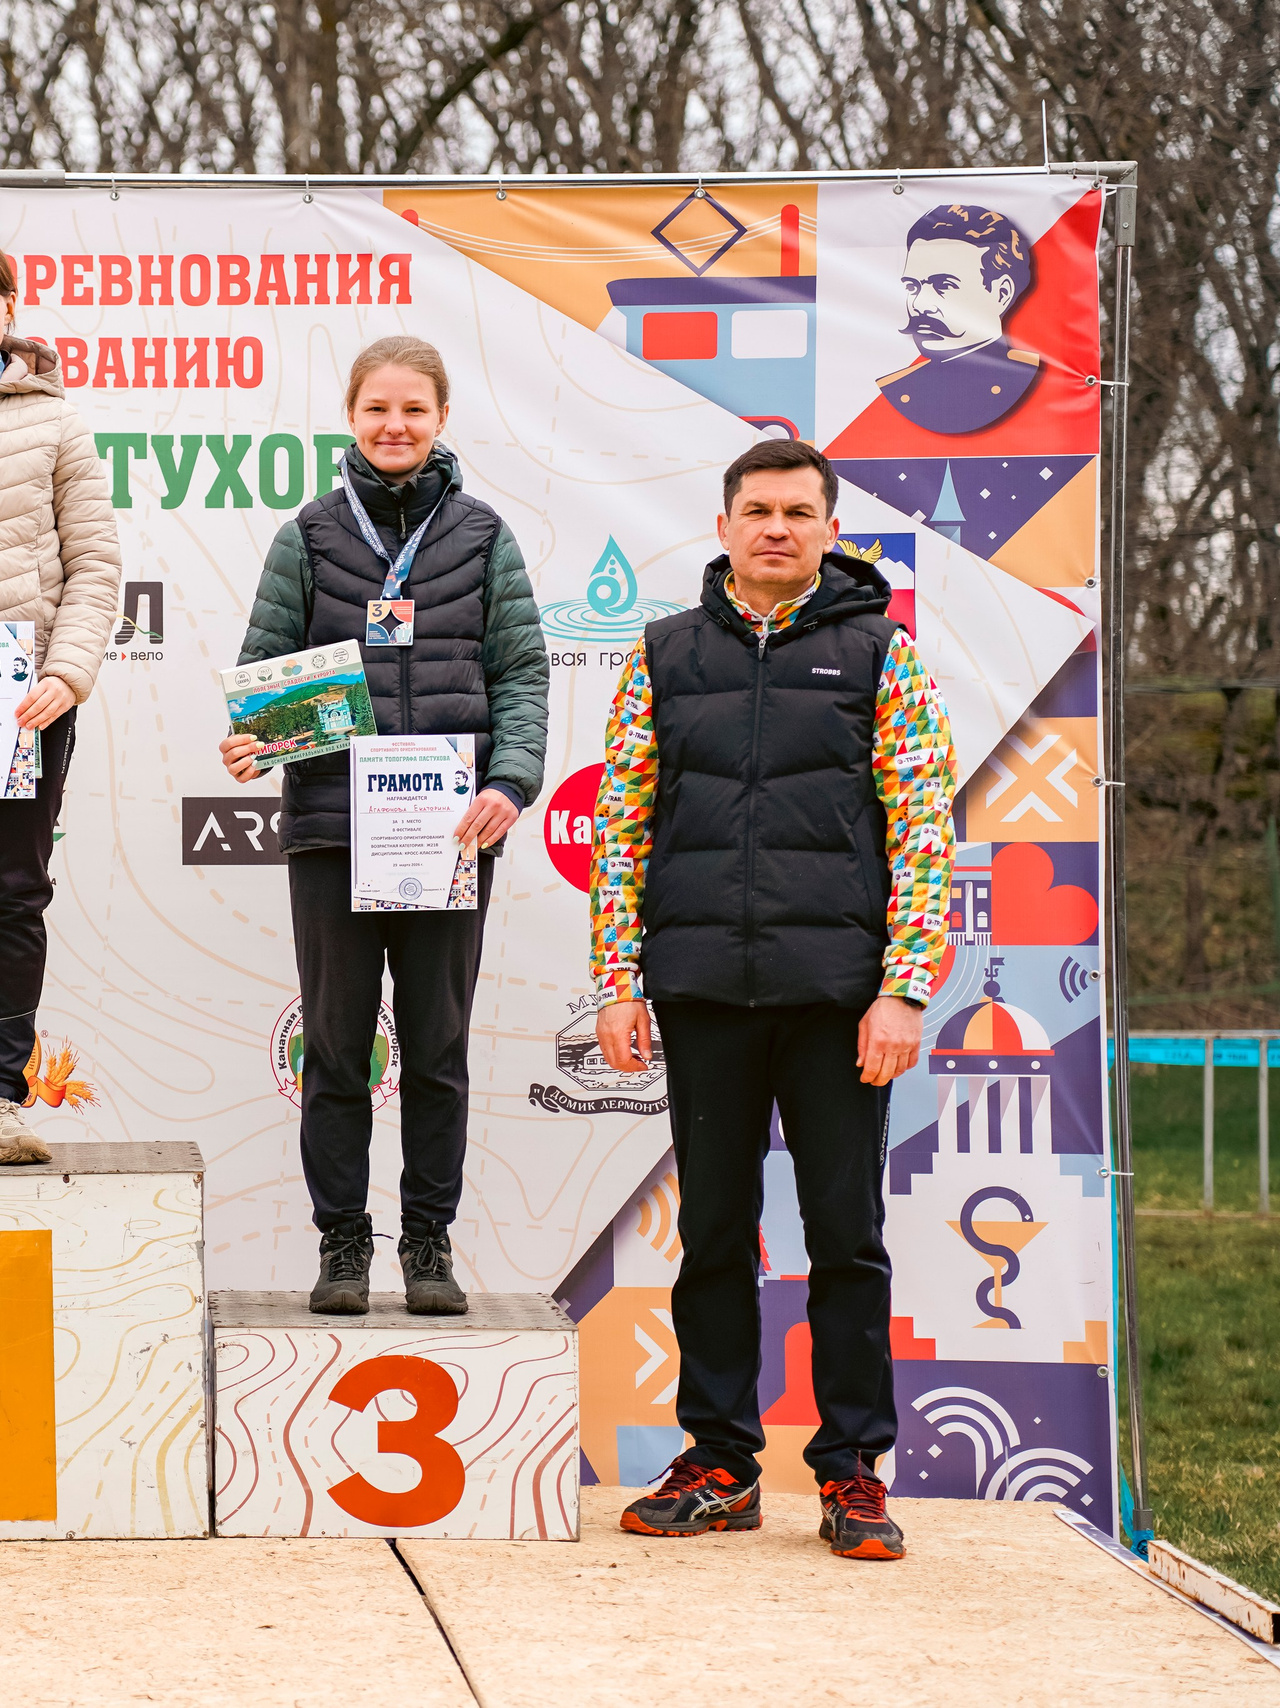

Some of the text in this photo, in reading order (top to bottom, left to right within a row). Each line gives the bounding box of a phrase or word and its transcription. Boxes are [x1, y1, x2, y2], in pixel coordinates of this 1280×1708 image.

[5, 253, 413, 306] РЕВНОВАНИЯ
[372, 603, 383, 618] 3
[130, 651, 164, 661] вело
[253, 670, 336, 694] ПОЛЕЗНЫЕ СЛАДОСТИ КУРОРТА
[811, 667, 841, 676] STROBBS
[290, 749, 324, 761] МИНЕРАЛЬНЫХ
[367, 773, 444, 792] ГРАМОТА
[278, 1012, 298, 1070] Канатная
[549, 1089, 596, 1112] ДОМИК
[326, 1354, 467, 1528] 3
